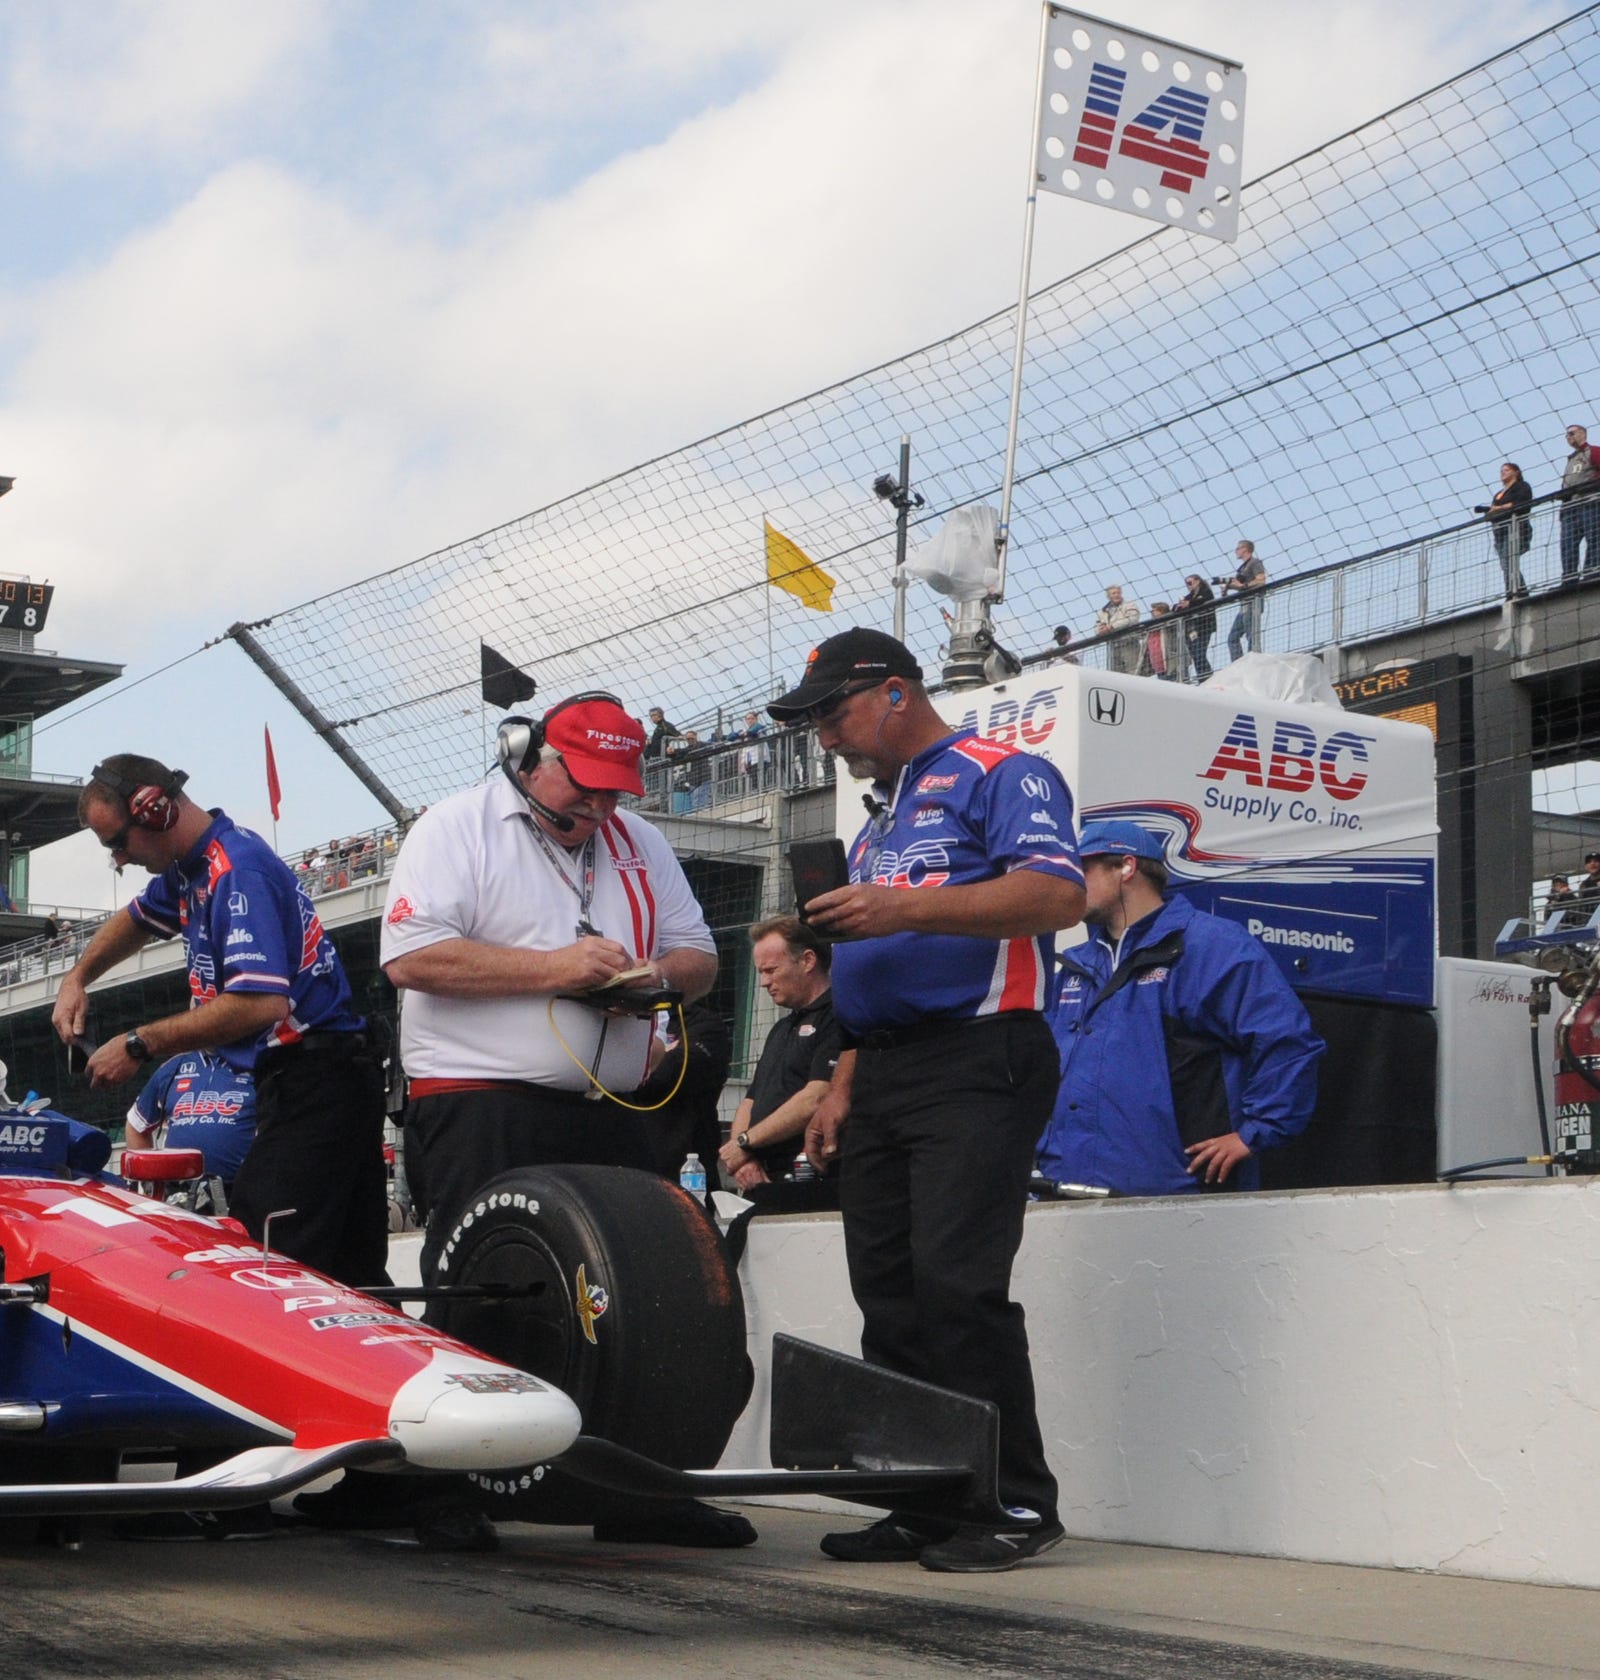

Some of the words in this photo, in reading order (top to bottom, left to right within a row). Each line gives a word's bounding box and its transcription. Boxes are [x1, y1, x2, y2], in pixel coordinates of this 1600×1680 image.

[1072, 62, 1210, 194] 14
[24, 608, 37, 627] 8
[1196, 714, 1377, 800] ABC
[1204, 787, 1282, 822] Supply
[1289, 800, 1323, 824] Co.
[1329, 806, 1363, 831] inc.
[1248, 918, 1354, 953] Panasonic
[224, 951, 268, 965] nasonic
[173, 1090, 250, 1119] ABC
[1555, 1116, 1592, 1136] YGEN
[438, 1191, 541, 1271] Firestone
[468, 1463, 552, 1496] estone
